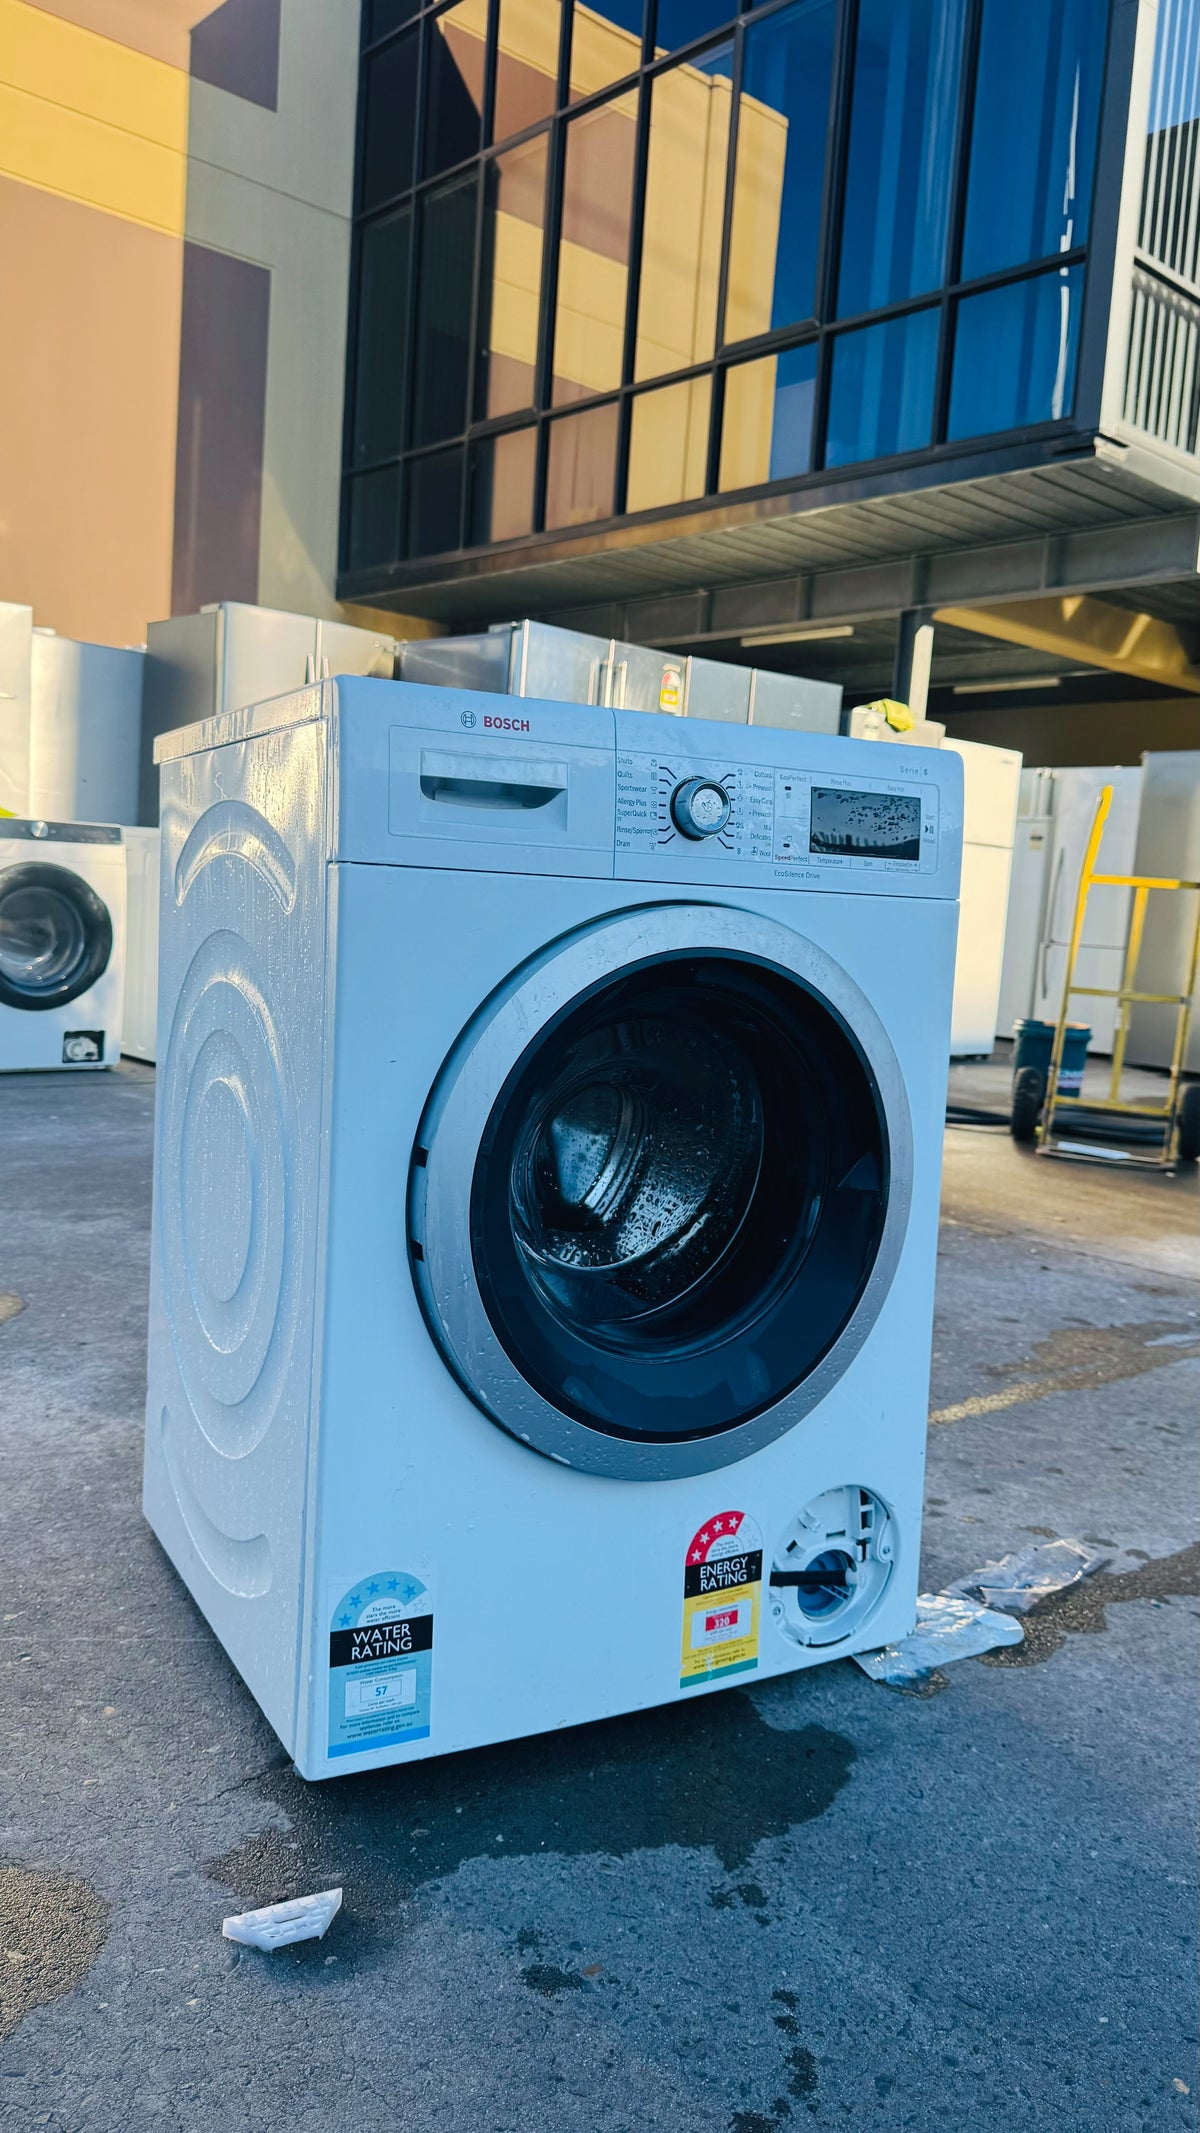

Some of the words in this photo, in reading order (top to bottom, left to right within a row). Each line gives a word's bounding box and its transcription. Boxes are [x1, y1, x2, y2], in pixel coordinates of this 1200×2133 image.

[484, 716, 530, 732] BOSCH
[900, 766, 918, 775] Serie
[780, 774, 807, 782] EcoPerfect
[618, 784, 647, 792] Sportswear
[618, 798, 634, 807] Allergy
[617, 808, 647, 818] SuperQuick
[750, 832, 772, 840] Delicates
[774, 854, 808, 862] SpeedPerfect
[774, 870, 804, 878] EcoSilence
[806, 872, 820, 880] Drive
[700, 1556, 748, 1578] ENERGY
[700, 1570, 747, 1592] RATING
[353, 1624, 410, 1645] WATER
[352, 1637, 412, 1660] RATING
[376, 1686, 388, 1696] 57
